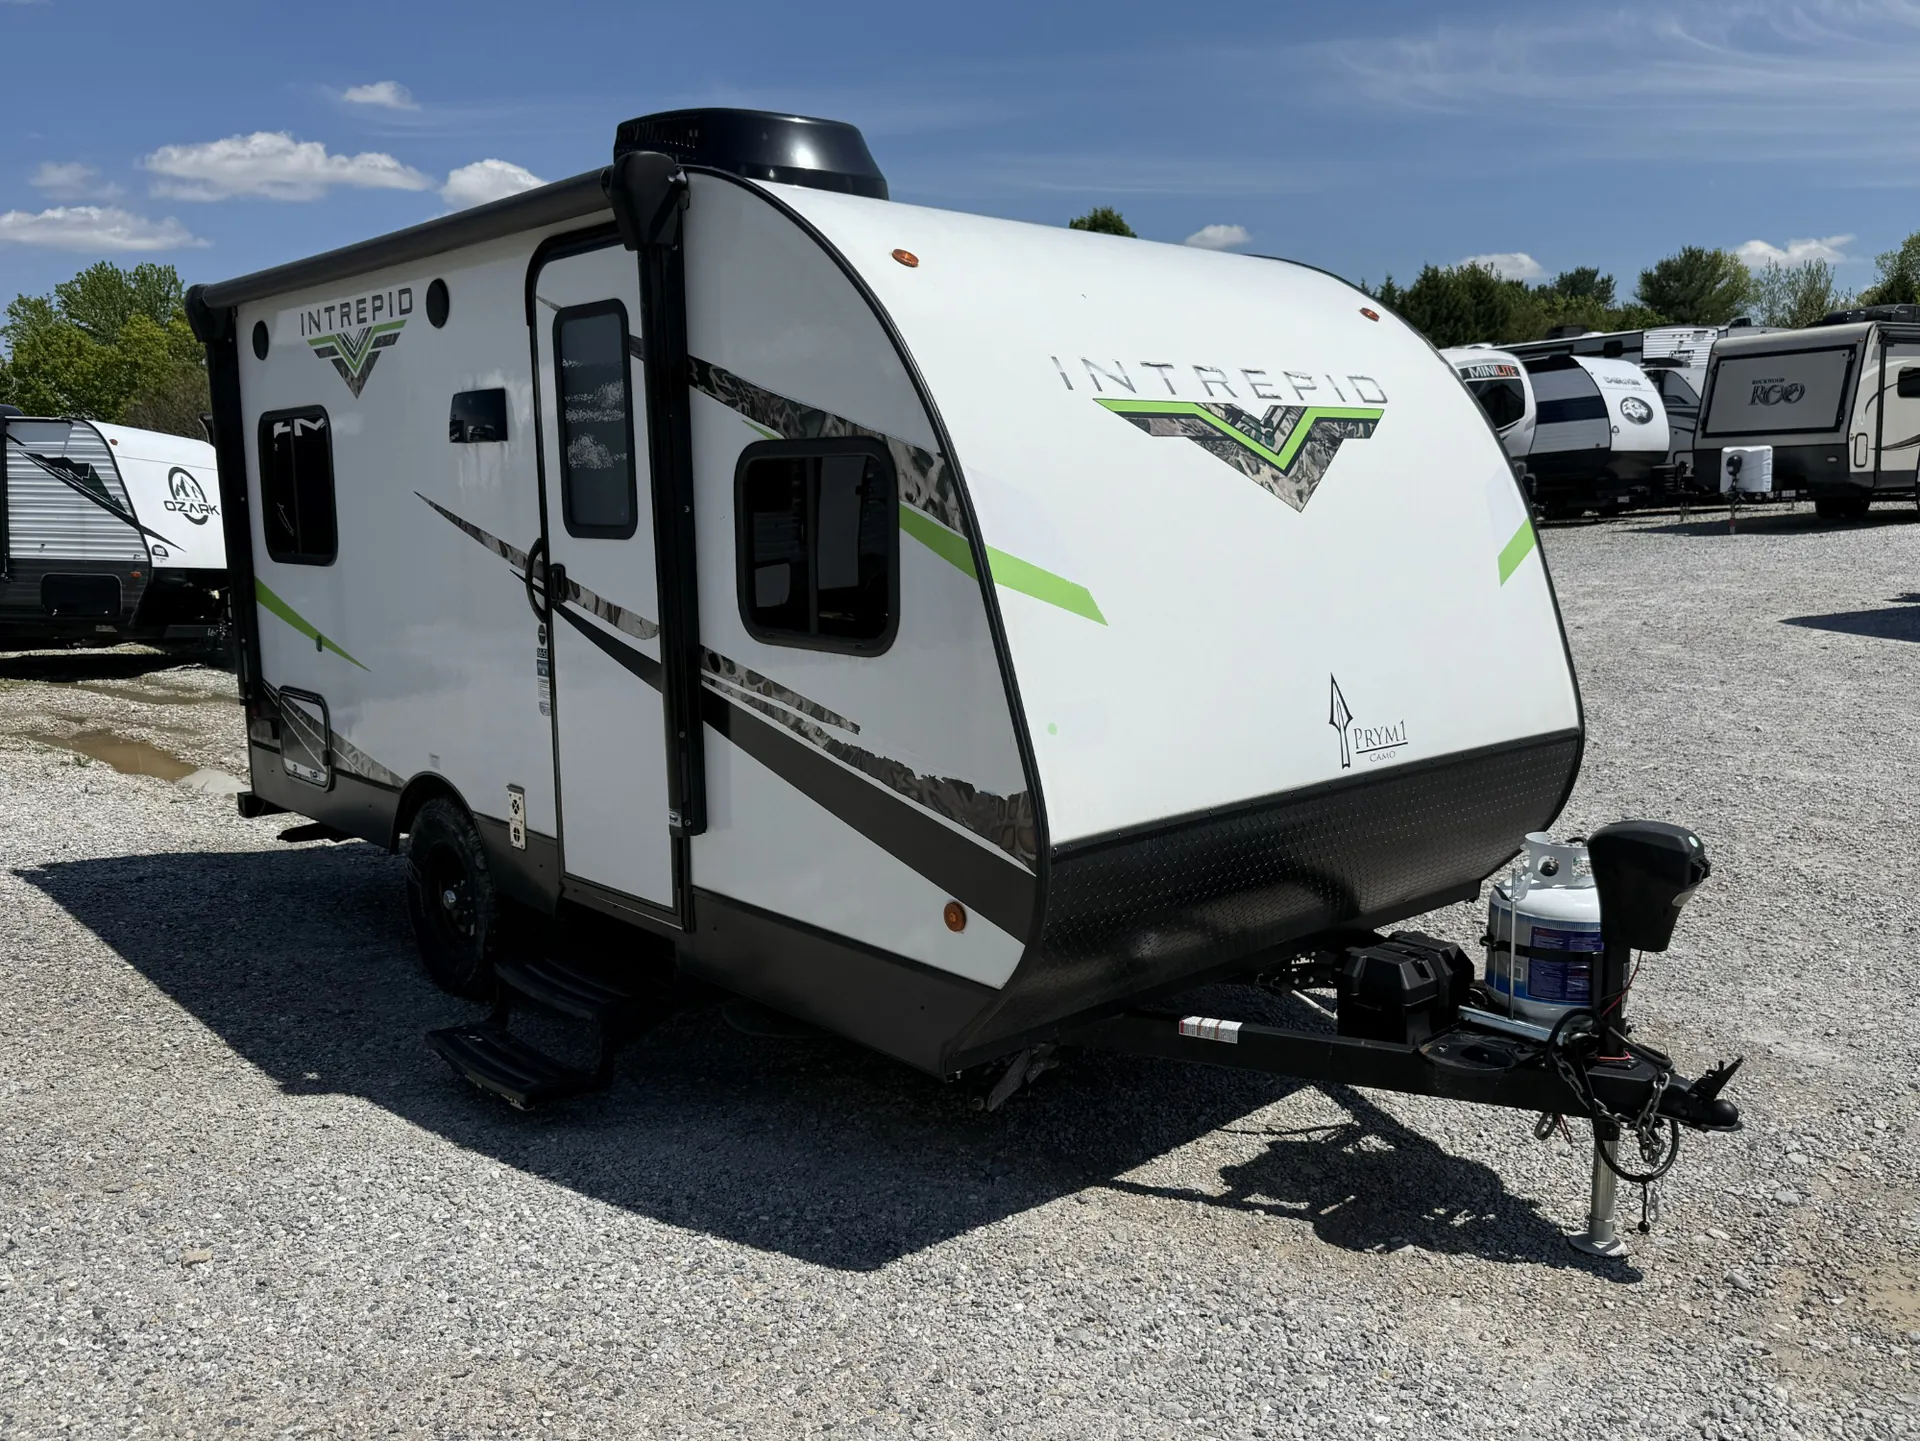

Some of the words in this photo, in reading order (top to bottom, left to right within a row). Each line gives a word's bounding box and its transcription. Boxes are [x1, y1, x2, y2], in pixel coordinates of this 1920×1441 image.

[300, 288, 413, 336] INTREPID
[1049, 355, 1388, 403] INTREPID
[1468, 364, 1517, 378] MINILITE
[1748, 382, 1806, 406] ROO
[163, 500, 221, 516] OZARK
[1353, 719, 1408, 750] PRYM1
[1369, 751, 1396, 762] CAMO
